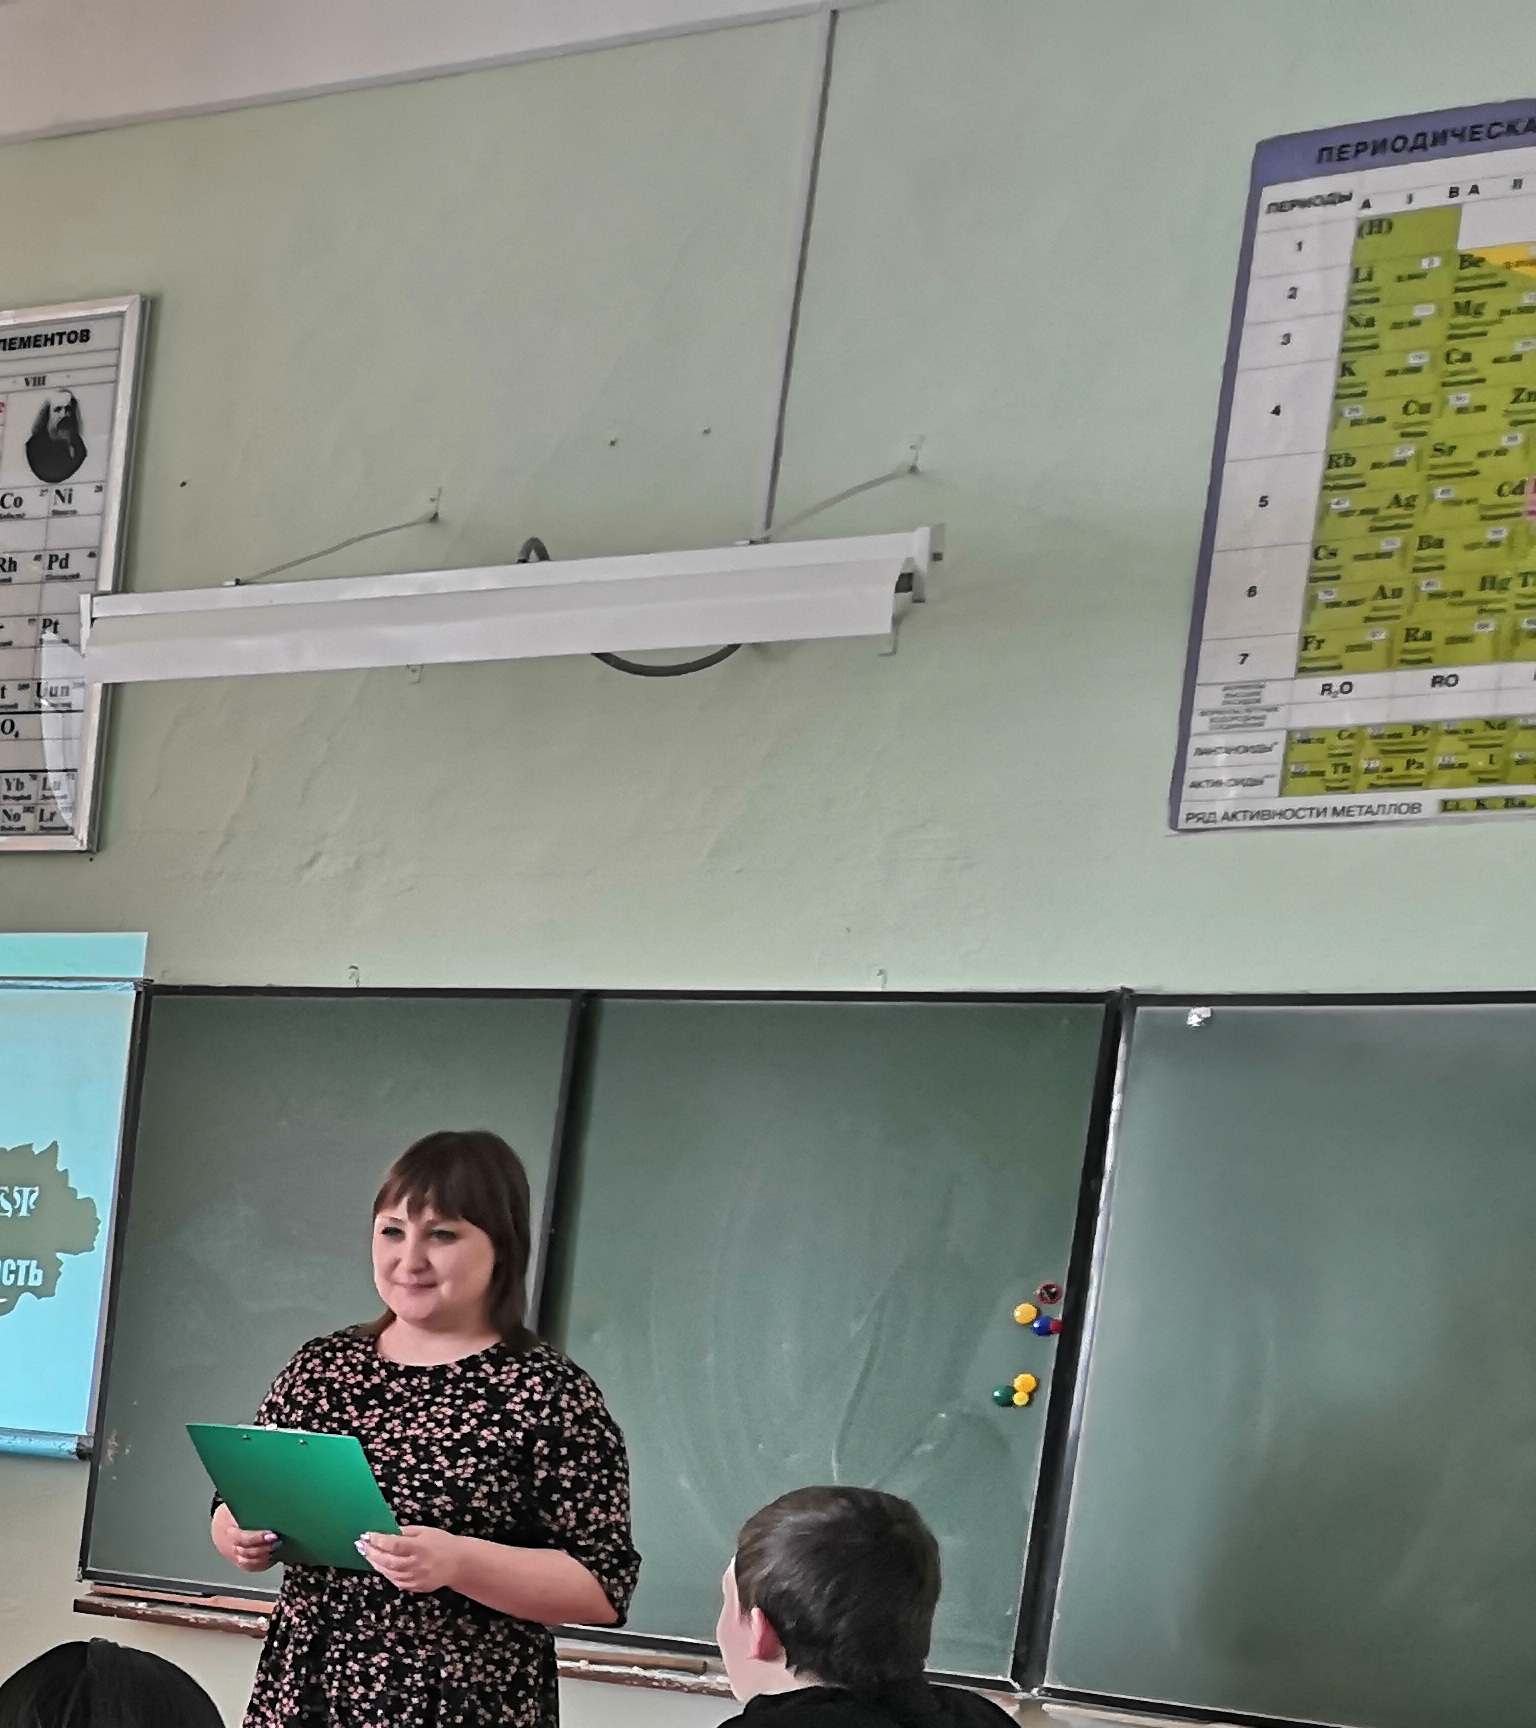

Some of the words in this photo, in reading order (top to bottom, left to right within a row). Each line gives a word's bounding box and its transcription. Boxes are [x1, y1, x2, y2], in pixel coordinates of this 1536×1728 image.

[0, 492, 24, 509] Co
[53, 488, 73, 505] Ni
[48, 553, 70, 570] Pd
